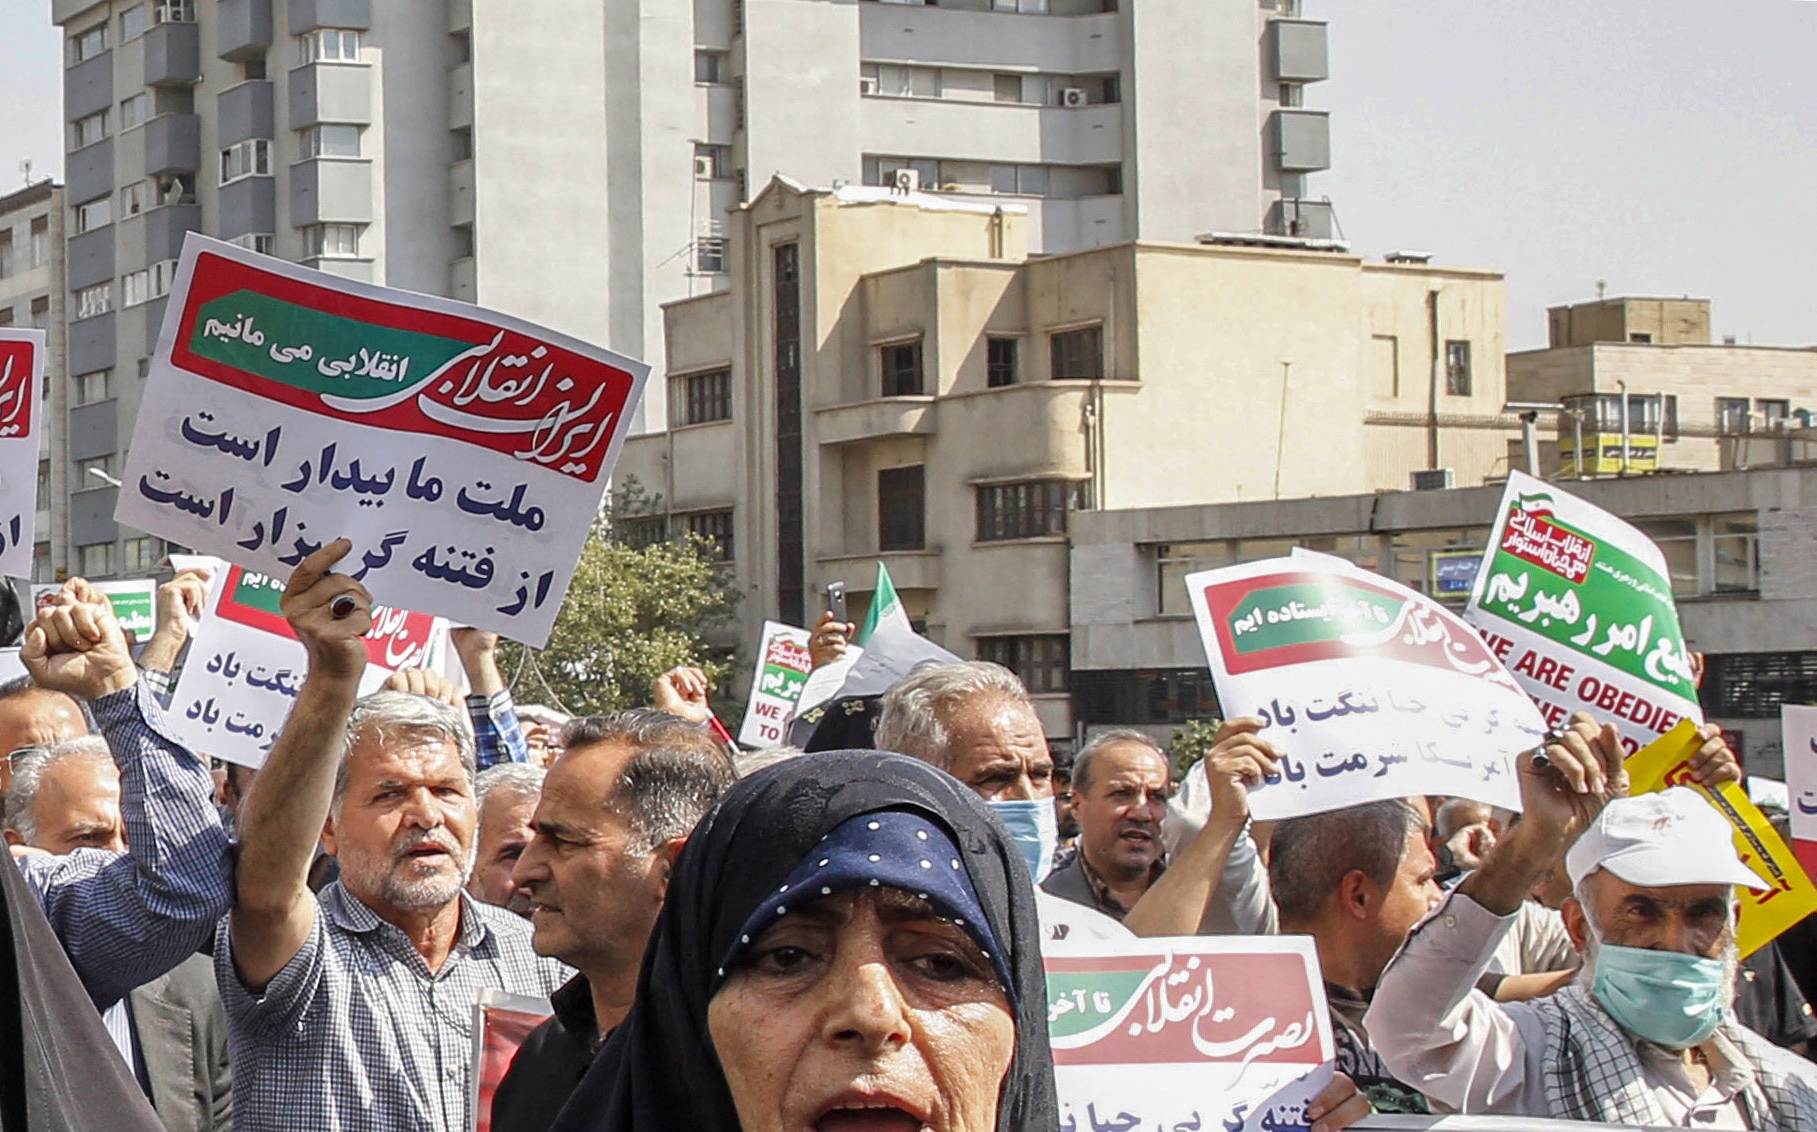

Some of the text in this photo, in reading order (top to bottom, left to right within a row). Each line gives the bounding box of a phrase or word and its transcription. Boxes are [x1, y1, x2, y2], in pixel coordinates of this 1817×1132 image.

[203, 313, 410, 383] انقلابی می مانیم
[320, 329, 552, 414] انقلابی
[180, 411, 547, 533] ملت ما بیدار است
[139, 469, 234, 526] است
[350, 530, 409, 582] گر
[412, 542, 496, 590] فتنه
[497, 569, 555, 616] از
[1267, 600, 1333, 624] یستاده
[1485, 571, 1597, 648] رهبریم
[1234, 607, 1264, 636] ایم
[1591, 614, 1654, 656] امر
[206, 651, 241, 687] باد
[1513, 649, 1575, 692] ARE
[1577, 676, 1688, 735] OBEDIE
[186, 697, 220, 732] باد
[755, 701, 781, 719] WE
[759, 724, 780, 741] TO
[1256, 698, 1297, 733] باد
